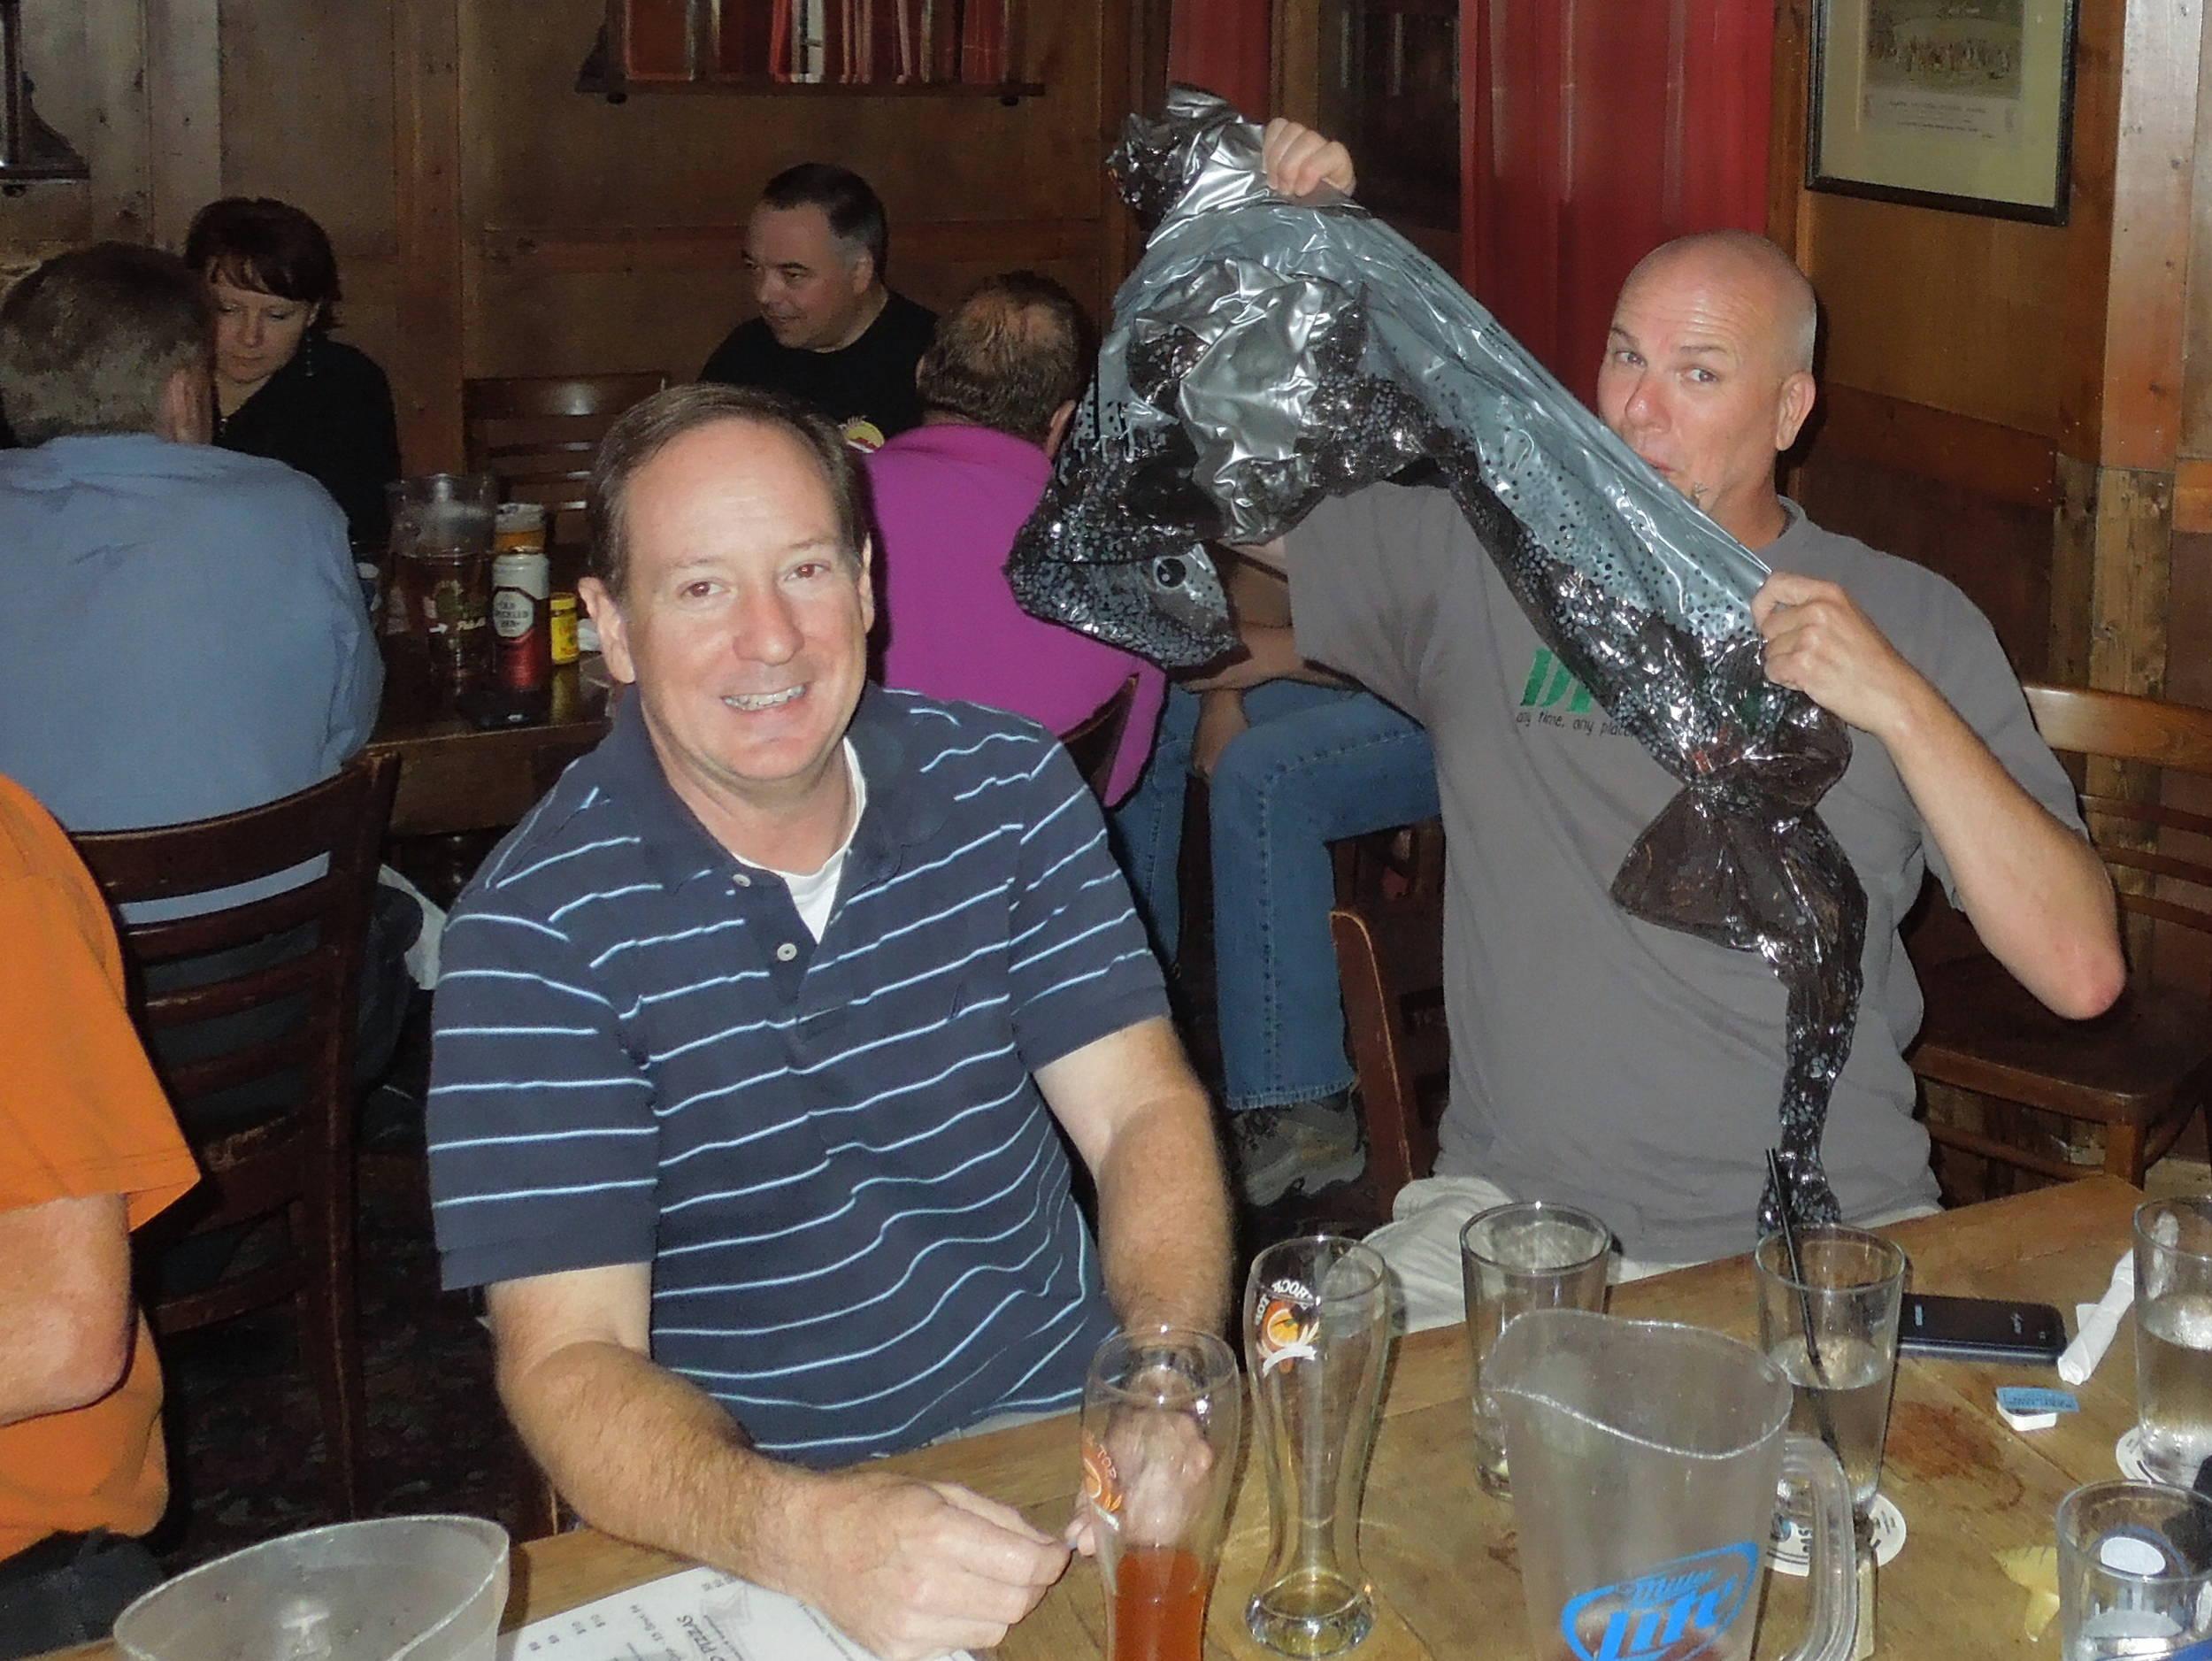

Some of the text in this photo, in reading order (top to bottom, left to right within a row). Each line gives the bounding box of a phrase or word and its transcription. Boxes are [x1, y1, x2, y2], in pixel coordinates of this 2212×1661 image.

[1573, 719, 1594, 736] any
[1097, 1443, 1117, 1480] TOP
[676, 1614, 718, 1655] PIZZAS
